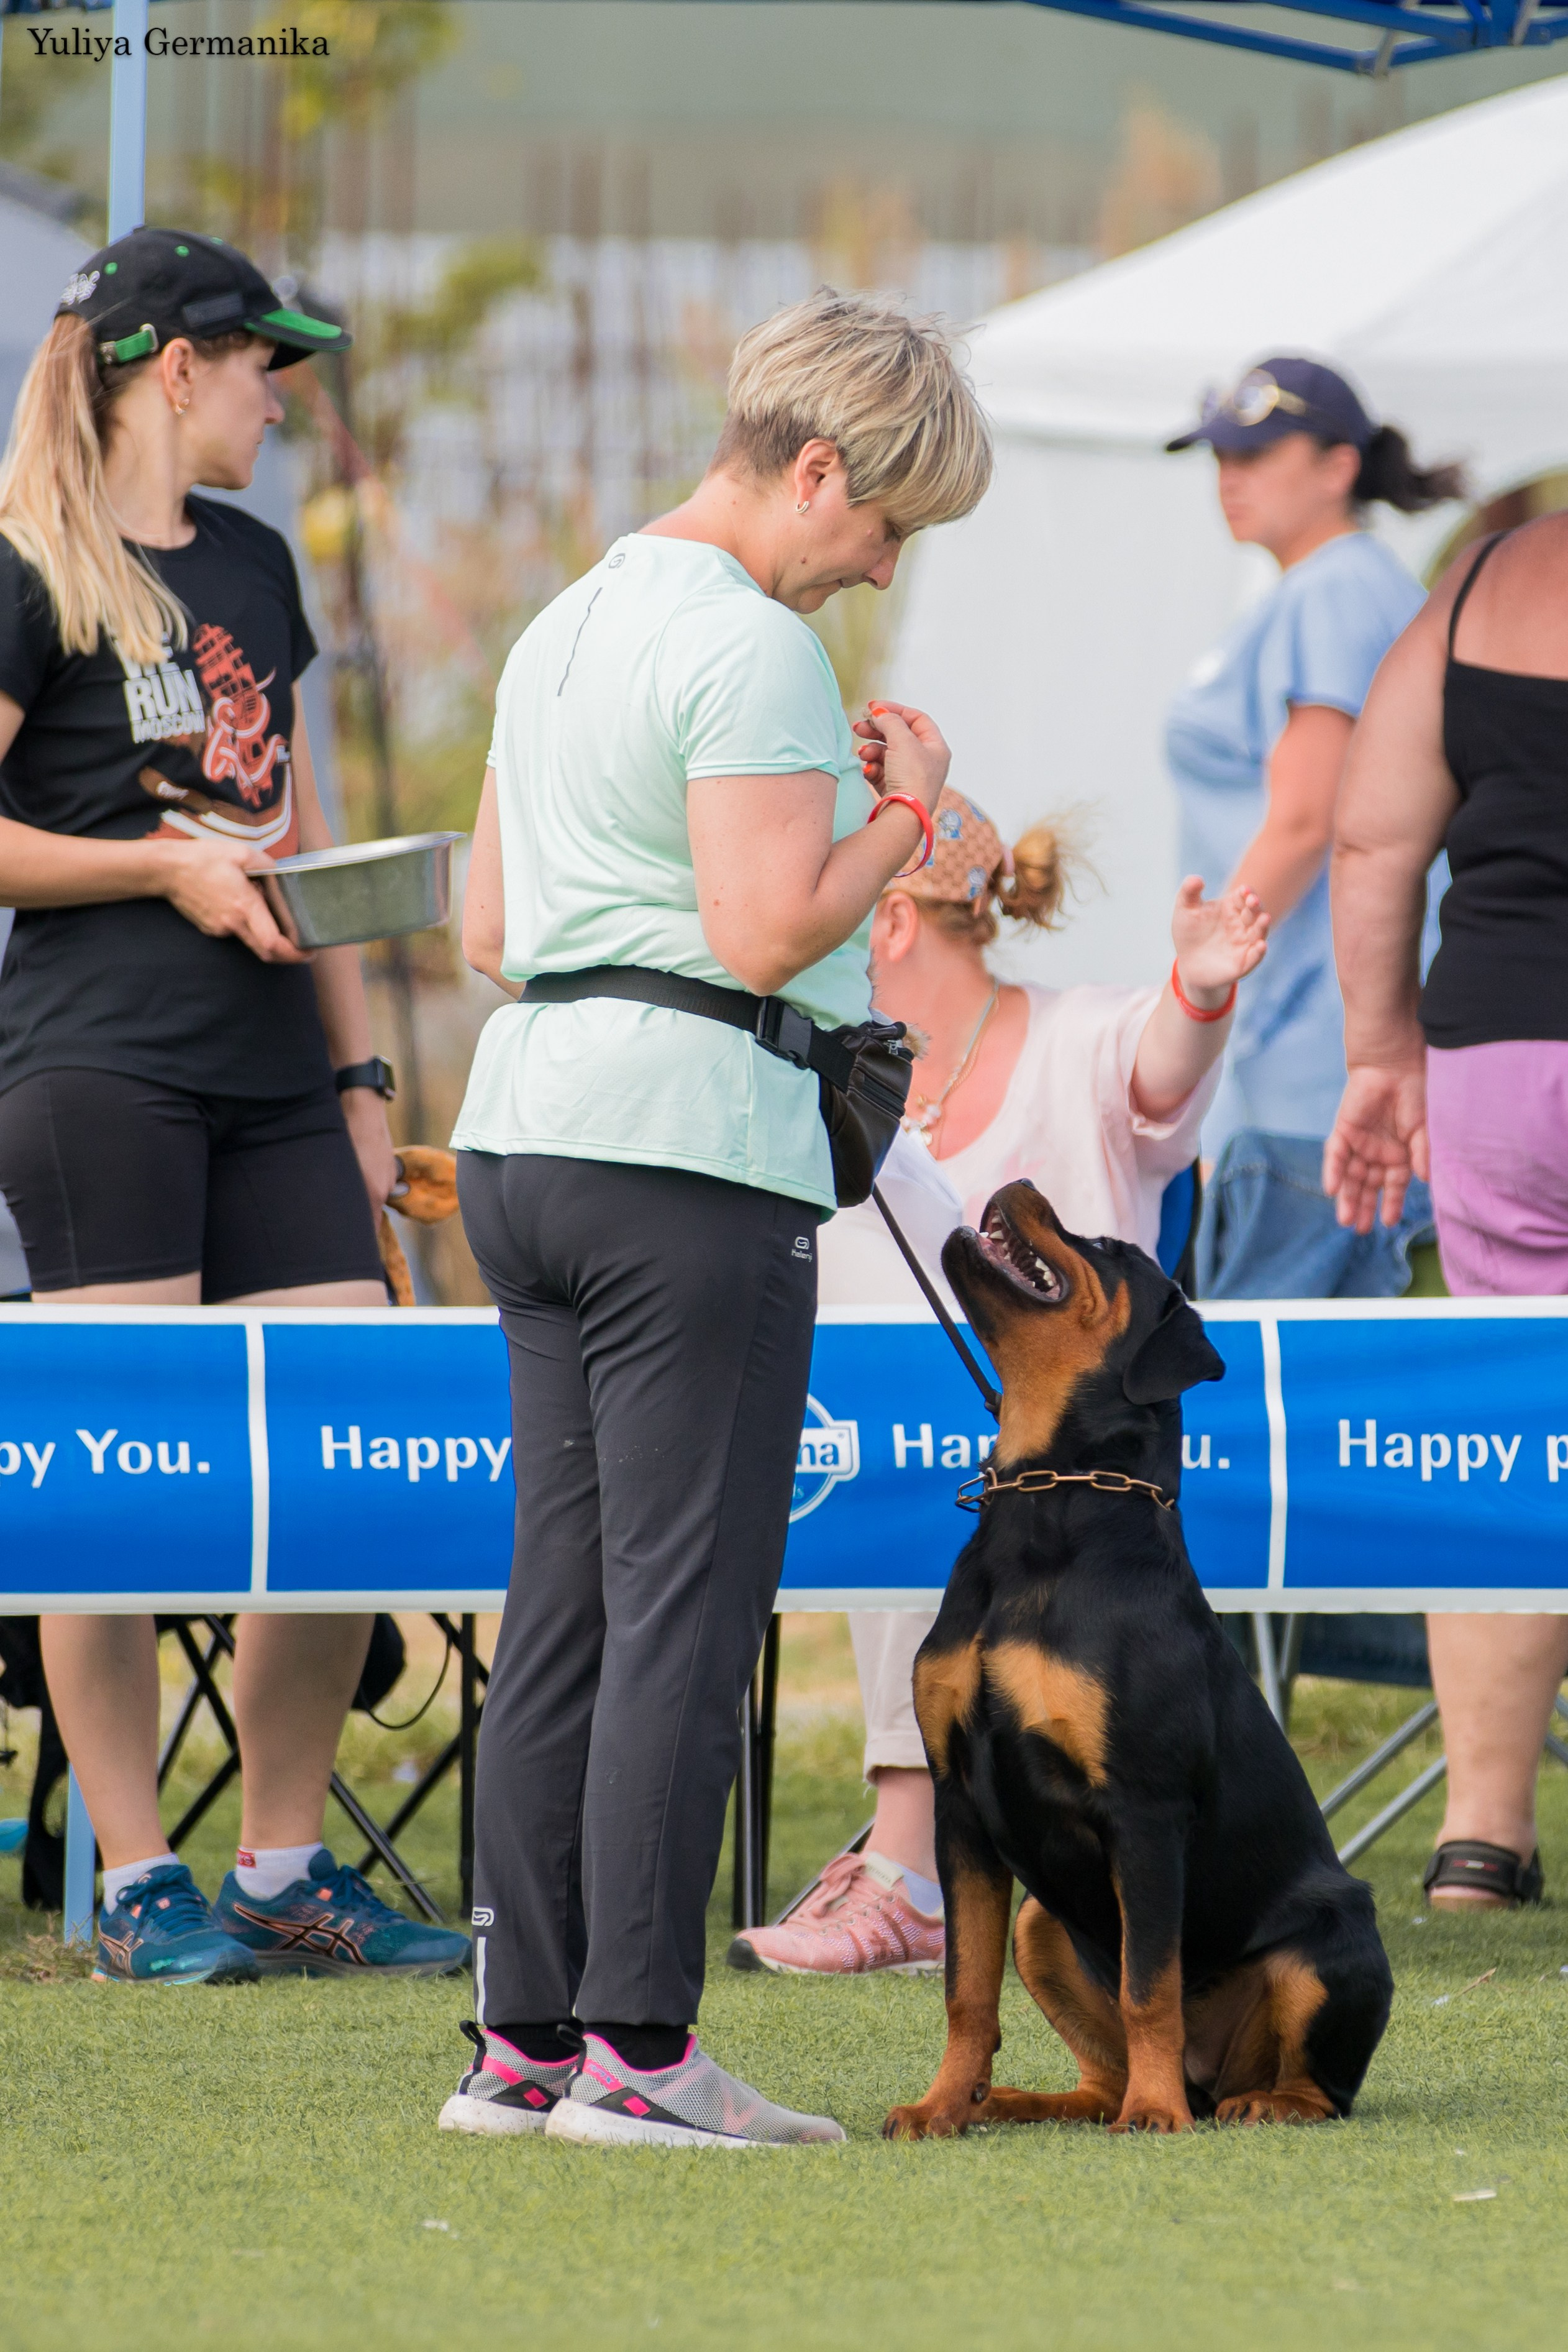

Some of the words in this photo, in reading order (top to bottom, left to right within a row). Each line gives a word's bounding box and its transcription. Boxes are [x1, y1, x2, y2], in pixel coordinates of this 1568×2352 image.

[124, 669, 204, 721] RUN
[132, 710, 206, 743] MOSCOW
[76, 1429, 211, 1475] You.
[321, 1425, 511, 1483] Happy
[1339, 1419, 1522, 1483] Happy
